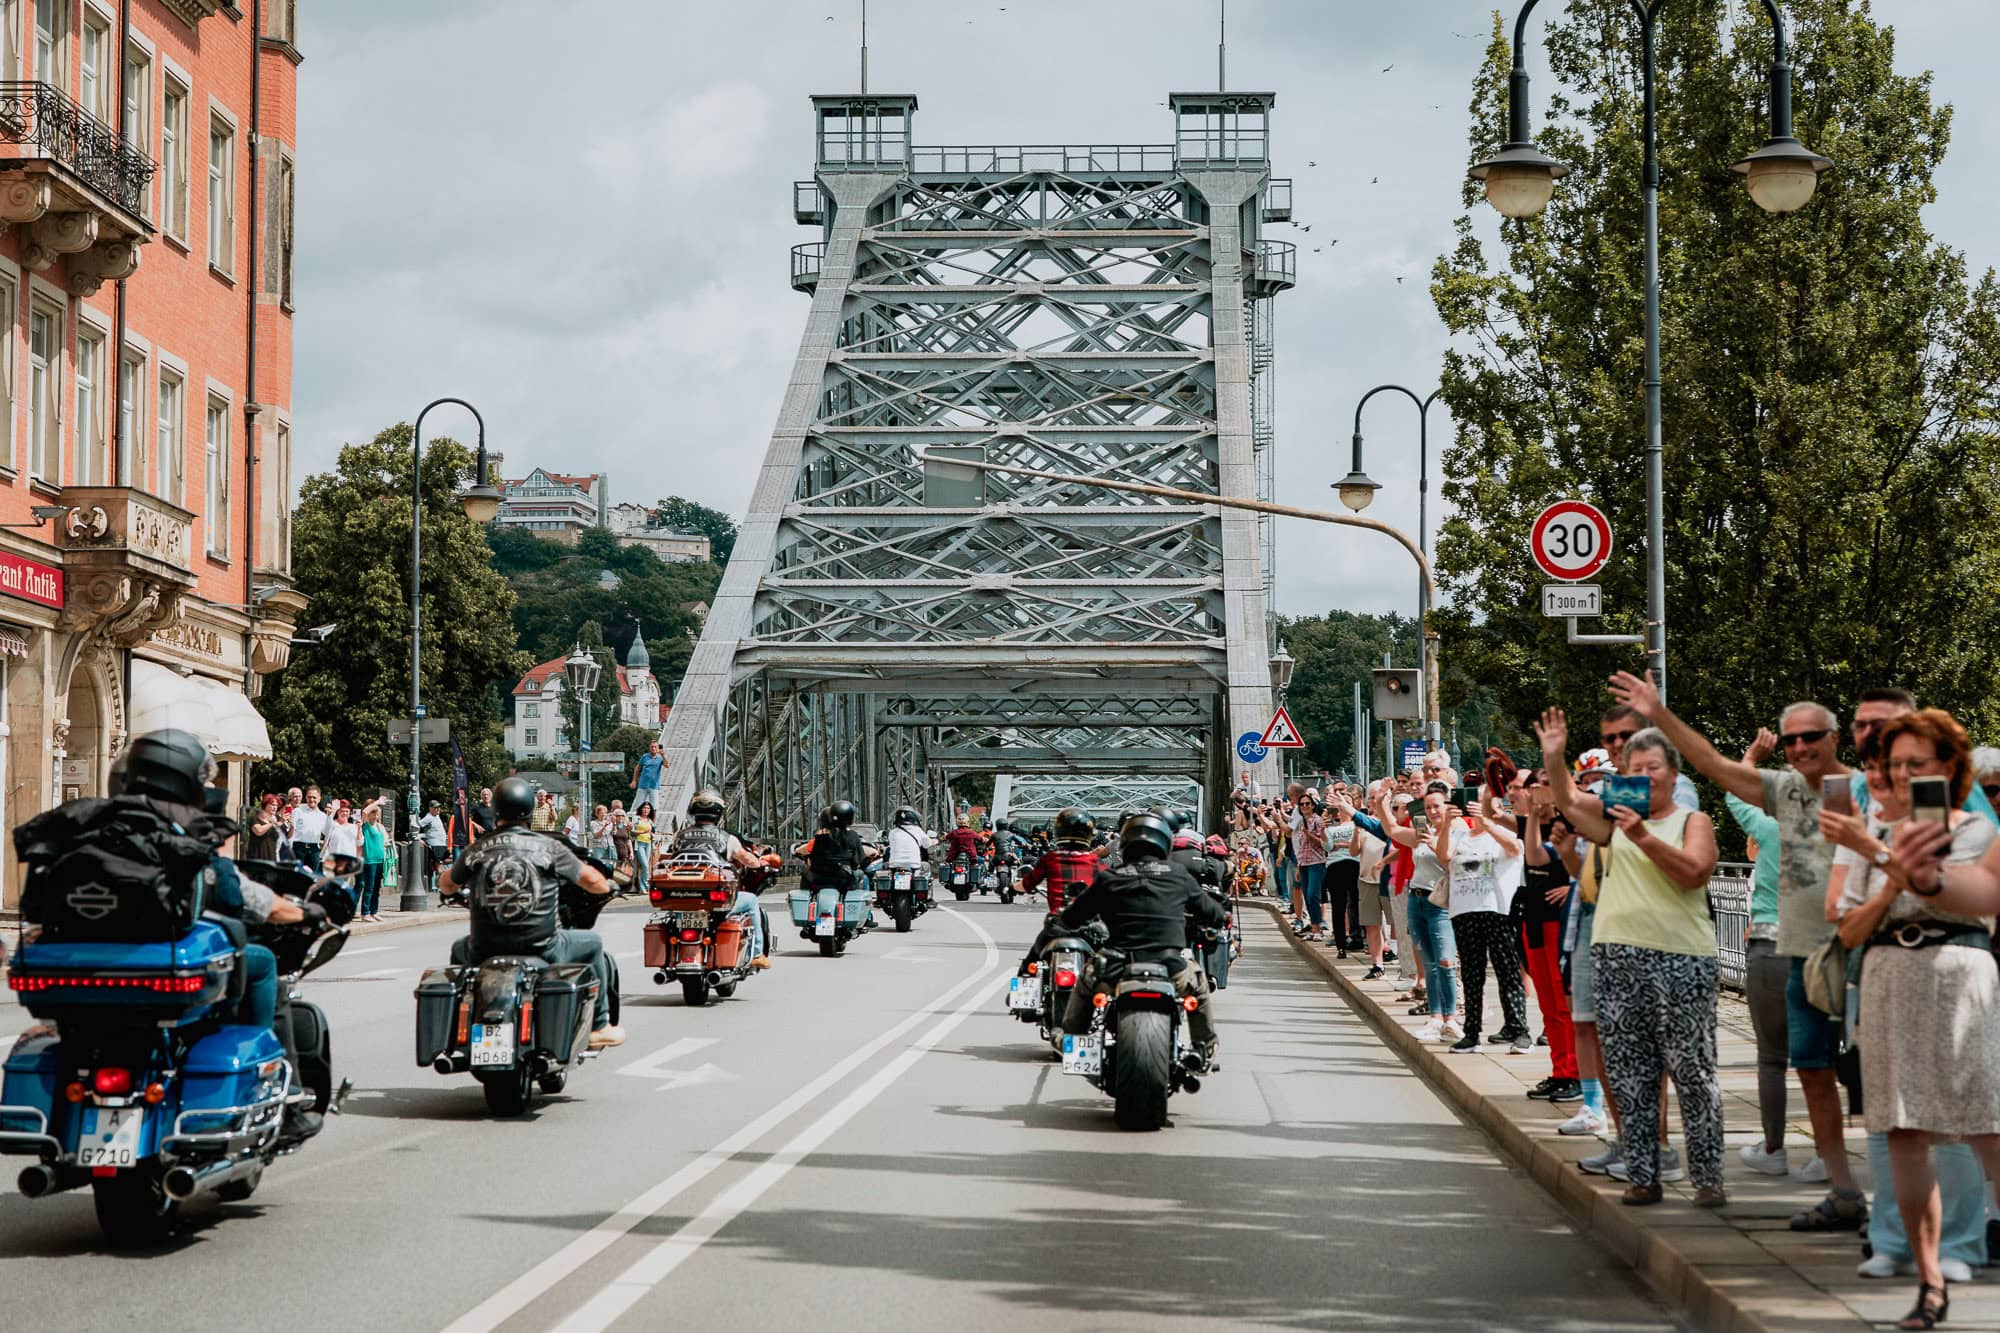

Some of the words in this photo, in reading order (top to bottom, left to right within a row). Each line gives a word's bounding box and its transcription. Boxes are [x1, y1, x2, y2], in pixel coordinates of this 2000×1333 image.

[1549, 524, 1592, 558] 30
[0, 565, 22, 590] ant
[26, 566, 57, 601] Antik
[1557, 597, 1575, 608] 300
[1578, 599, 1586, 608] m
[486, 1025, 501, 1037] BZ
[109, 1110, 119, 1126] A
